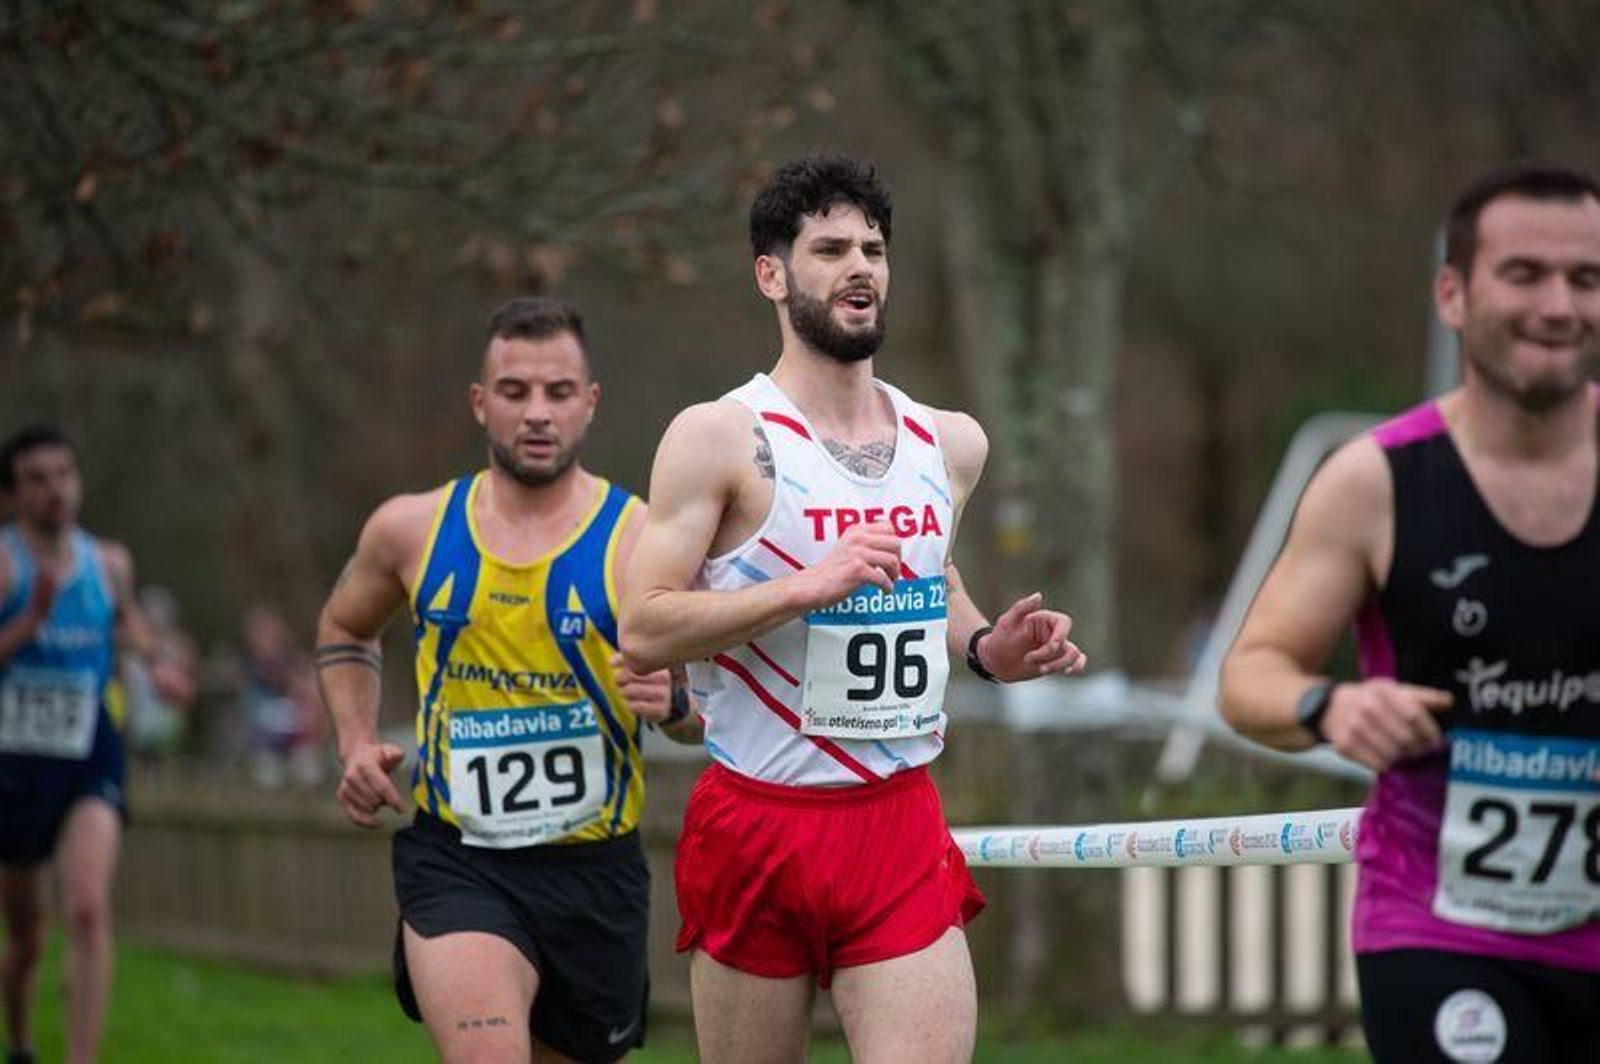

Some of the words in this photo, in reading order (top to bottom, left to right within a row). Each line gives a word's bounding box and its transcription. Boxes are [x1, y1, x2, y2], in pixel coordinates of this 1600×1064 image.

[847, 629, 928, 702] 96
[450, 710, 561, 740] Ribadavia
[467, 746, 586, 815] 129
